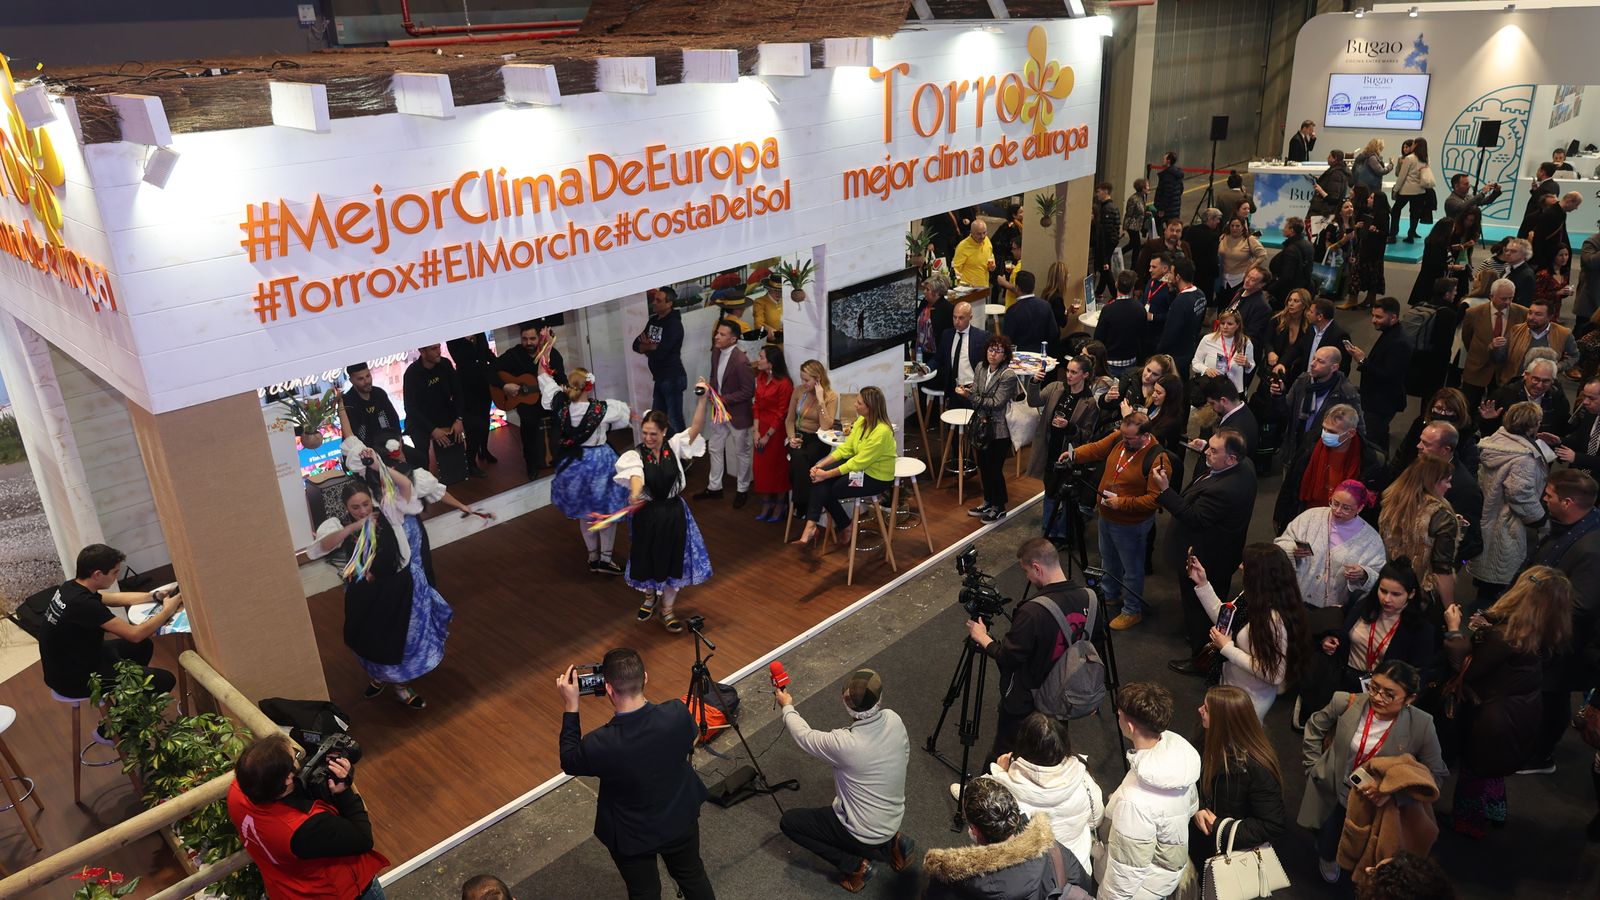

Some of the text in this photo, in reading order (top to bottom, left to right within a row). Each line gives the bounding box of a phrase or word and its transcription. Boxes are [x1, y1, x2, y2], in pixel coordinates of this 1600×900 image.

[1346, 39, 1403, 58] Bugao
[1363, 76, 1394, 86] Bugao
[842, 123, 1090, 202] mejor clima de europa
[1289, 188, 1314, 200] Bu
